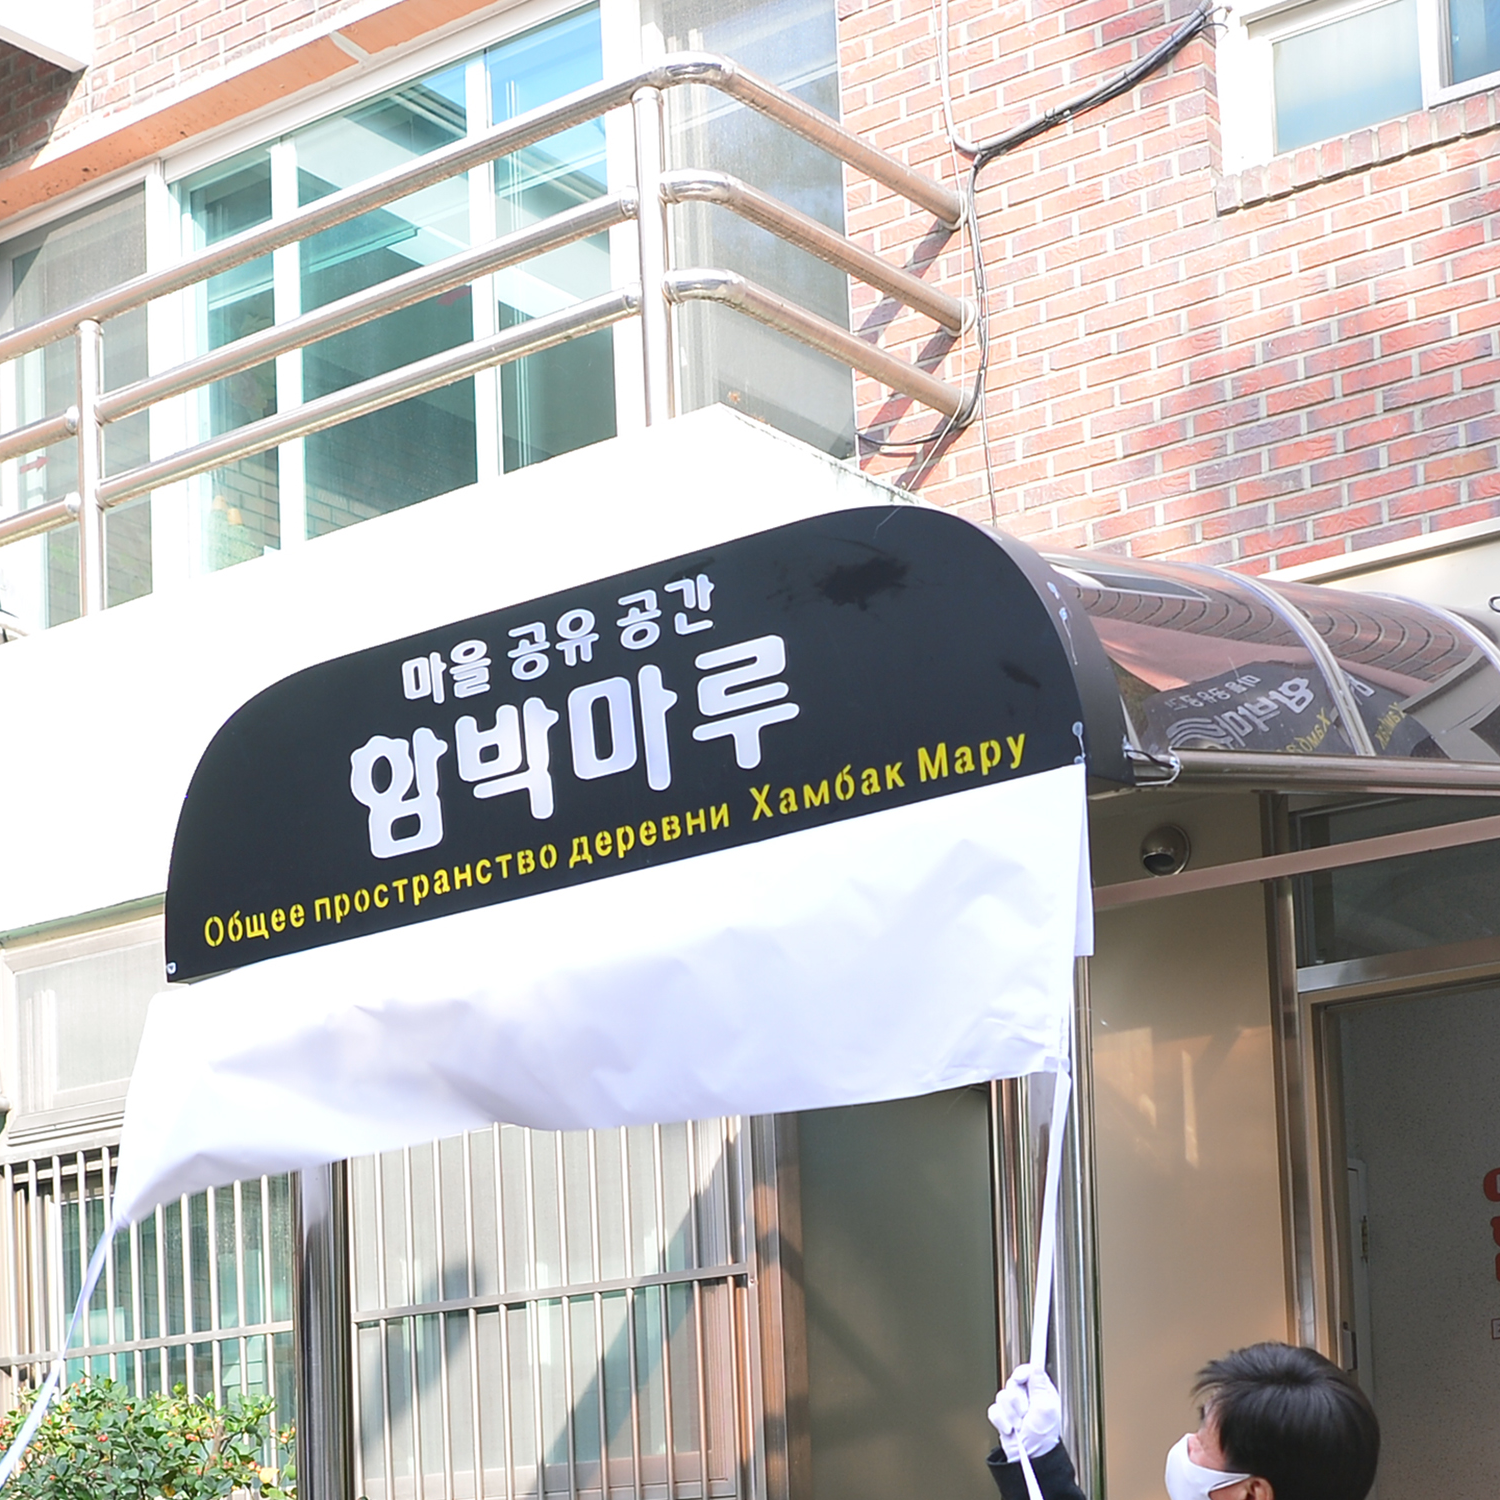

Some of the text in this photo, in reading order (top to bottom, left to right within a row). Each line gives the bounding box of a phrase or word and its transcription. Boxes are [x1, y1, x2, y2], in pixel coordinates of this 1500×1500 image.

[349, 634, 801, 860] 함박마루
[401, 573, 716, 705] 마을 공유 공간
[203, 732, 1028, 948] Общее пространство деревни Хамбак Мару
